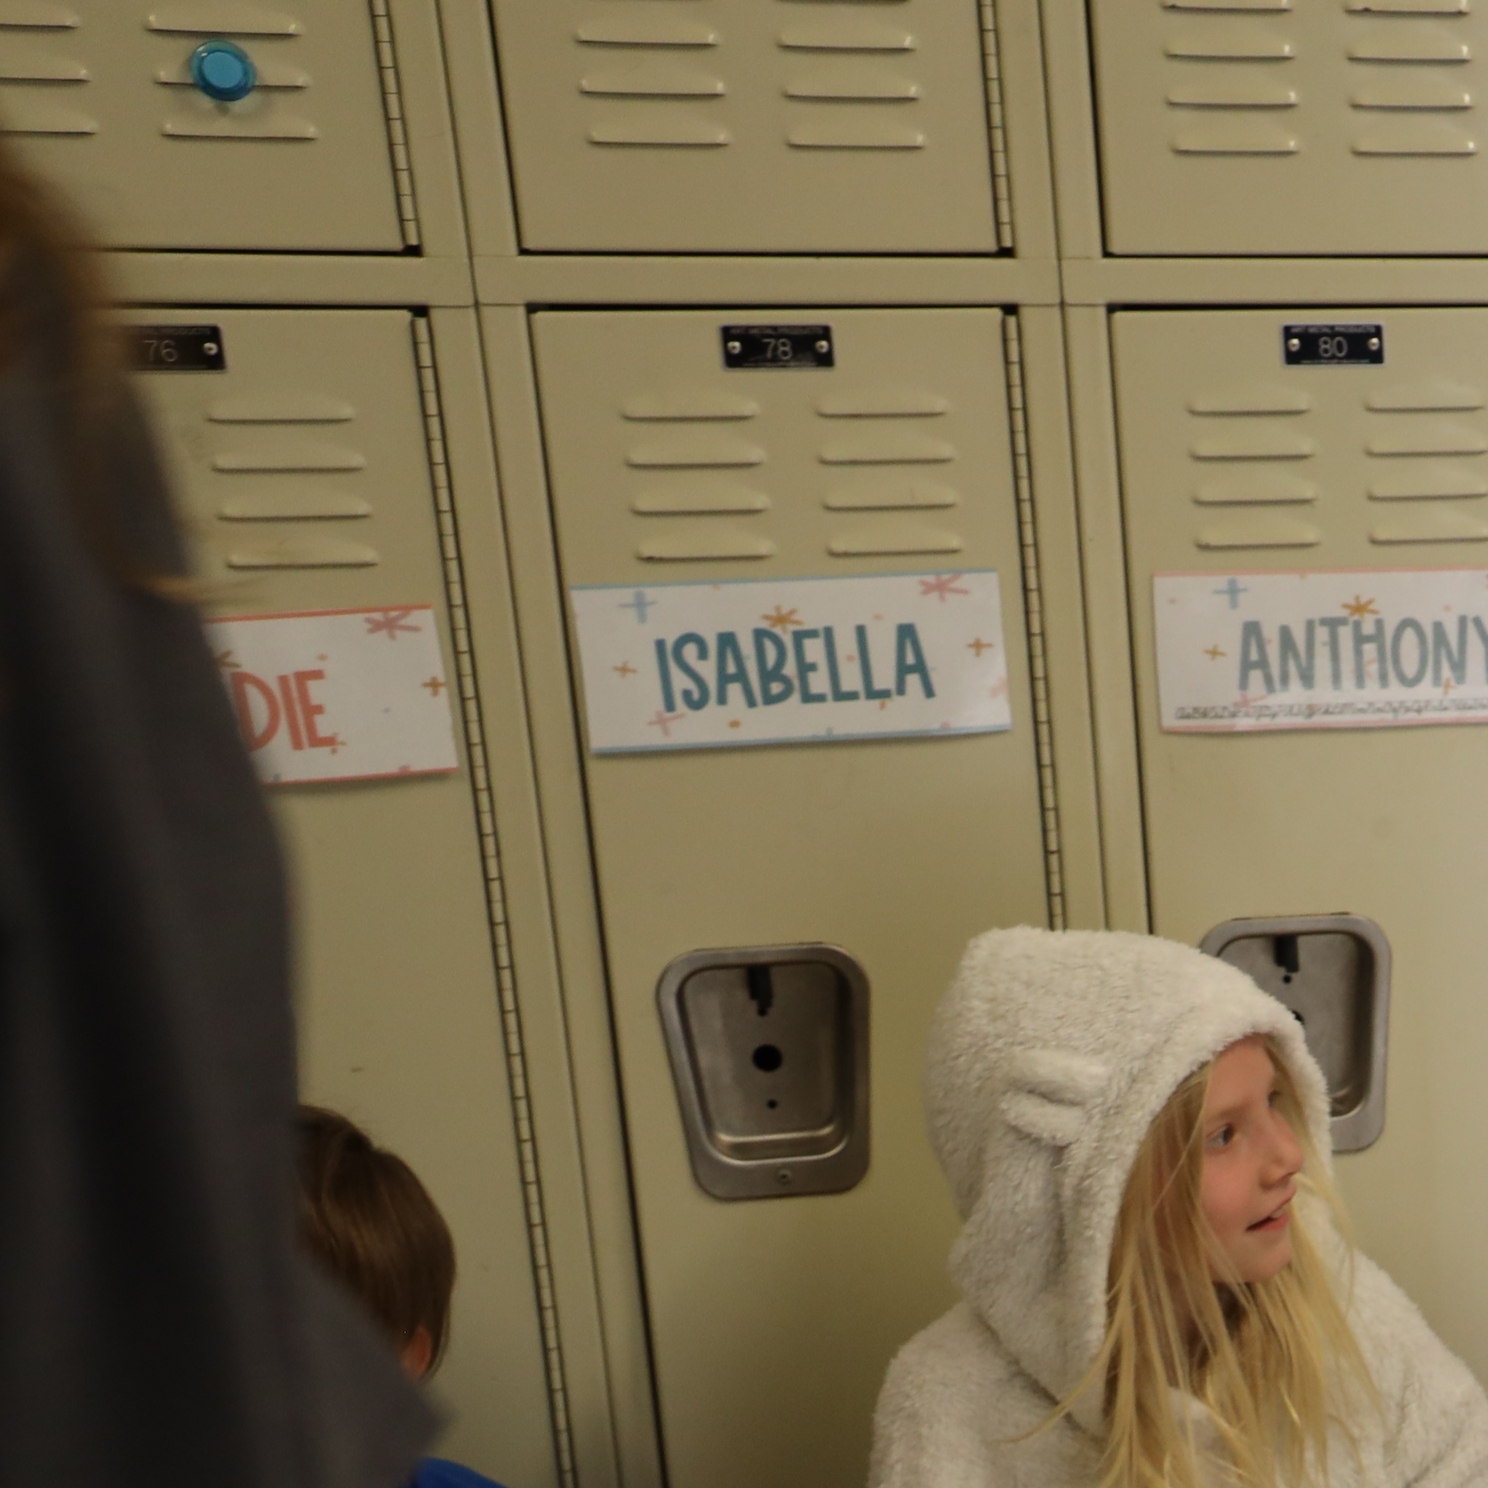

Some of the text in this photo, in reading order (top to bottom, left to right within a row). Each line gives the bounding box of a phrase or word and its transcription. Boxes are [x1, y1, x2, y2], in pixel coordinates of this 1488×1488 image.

[143, 339, 178, 362] 76
[762, 338, 793, 360] 78
[1318, 336, 1348, 358] 80
[654, 622, 936, 713] ISABELLA
